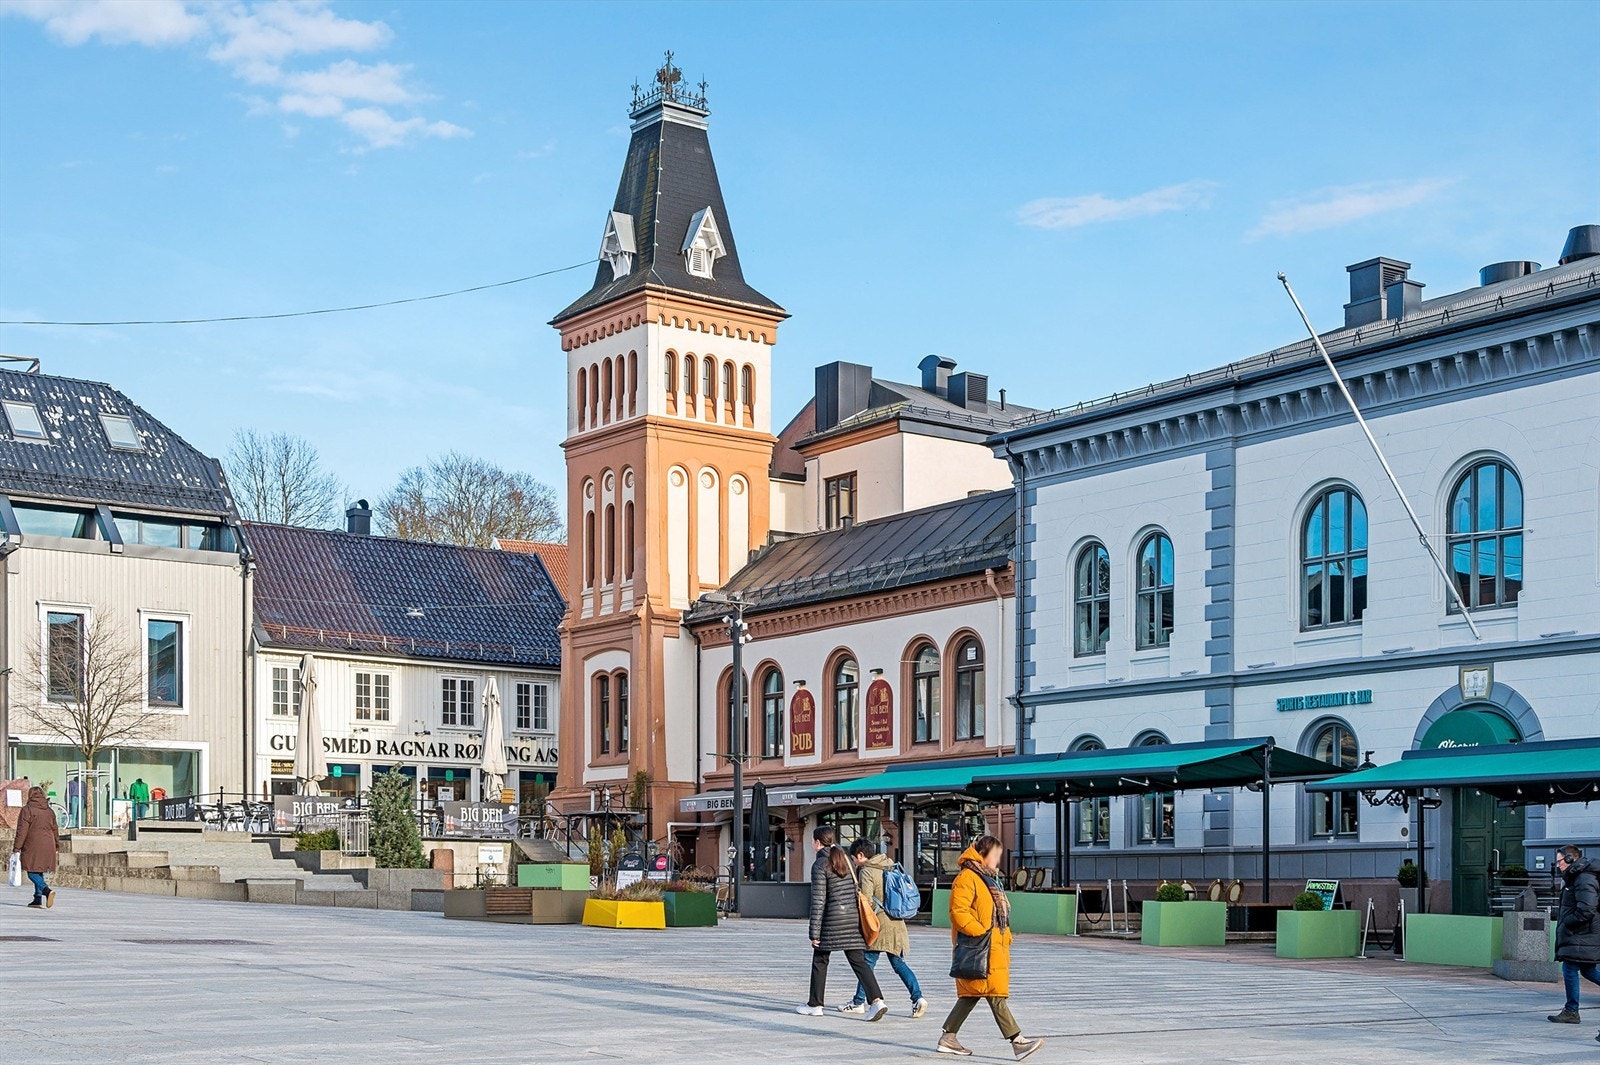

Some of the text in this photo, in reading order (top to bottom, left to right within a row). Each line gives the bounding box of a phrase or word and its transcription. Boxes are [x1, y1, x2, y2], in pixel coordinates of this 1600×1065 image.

[1277, 696, 1304, 712] SPORTS
[1305, 691, 1349, 709] RESTAURANT
[1357, 689, 1373, 704] BAR
[270, 734, 371, 754] GUSMED
[376, 740, 449, 758] RAGNAR
[534, 747, 558, 763] A/S
[792, 732, 813, 751] PUB
[164, 803, 187, 820] BIG BEN
[292, 801, 340, 818] BIG BEN
[707, 800, 719, 809] BIG
[720, 799, 734, 808] BEN
[460, 807, 504, 823] BIG BEN
